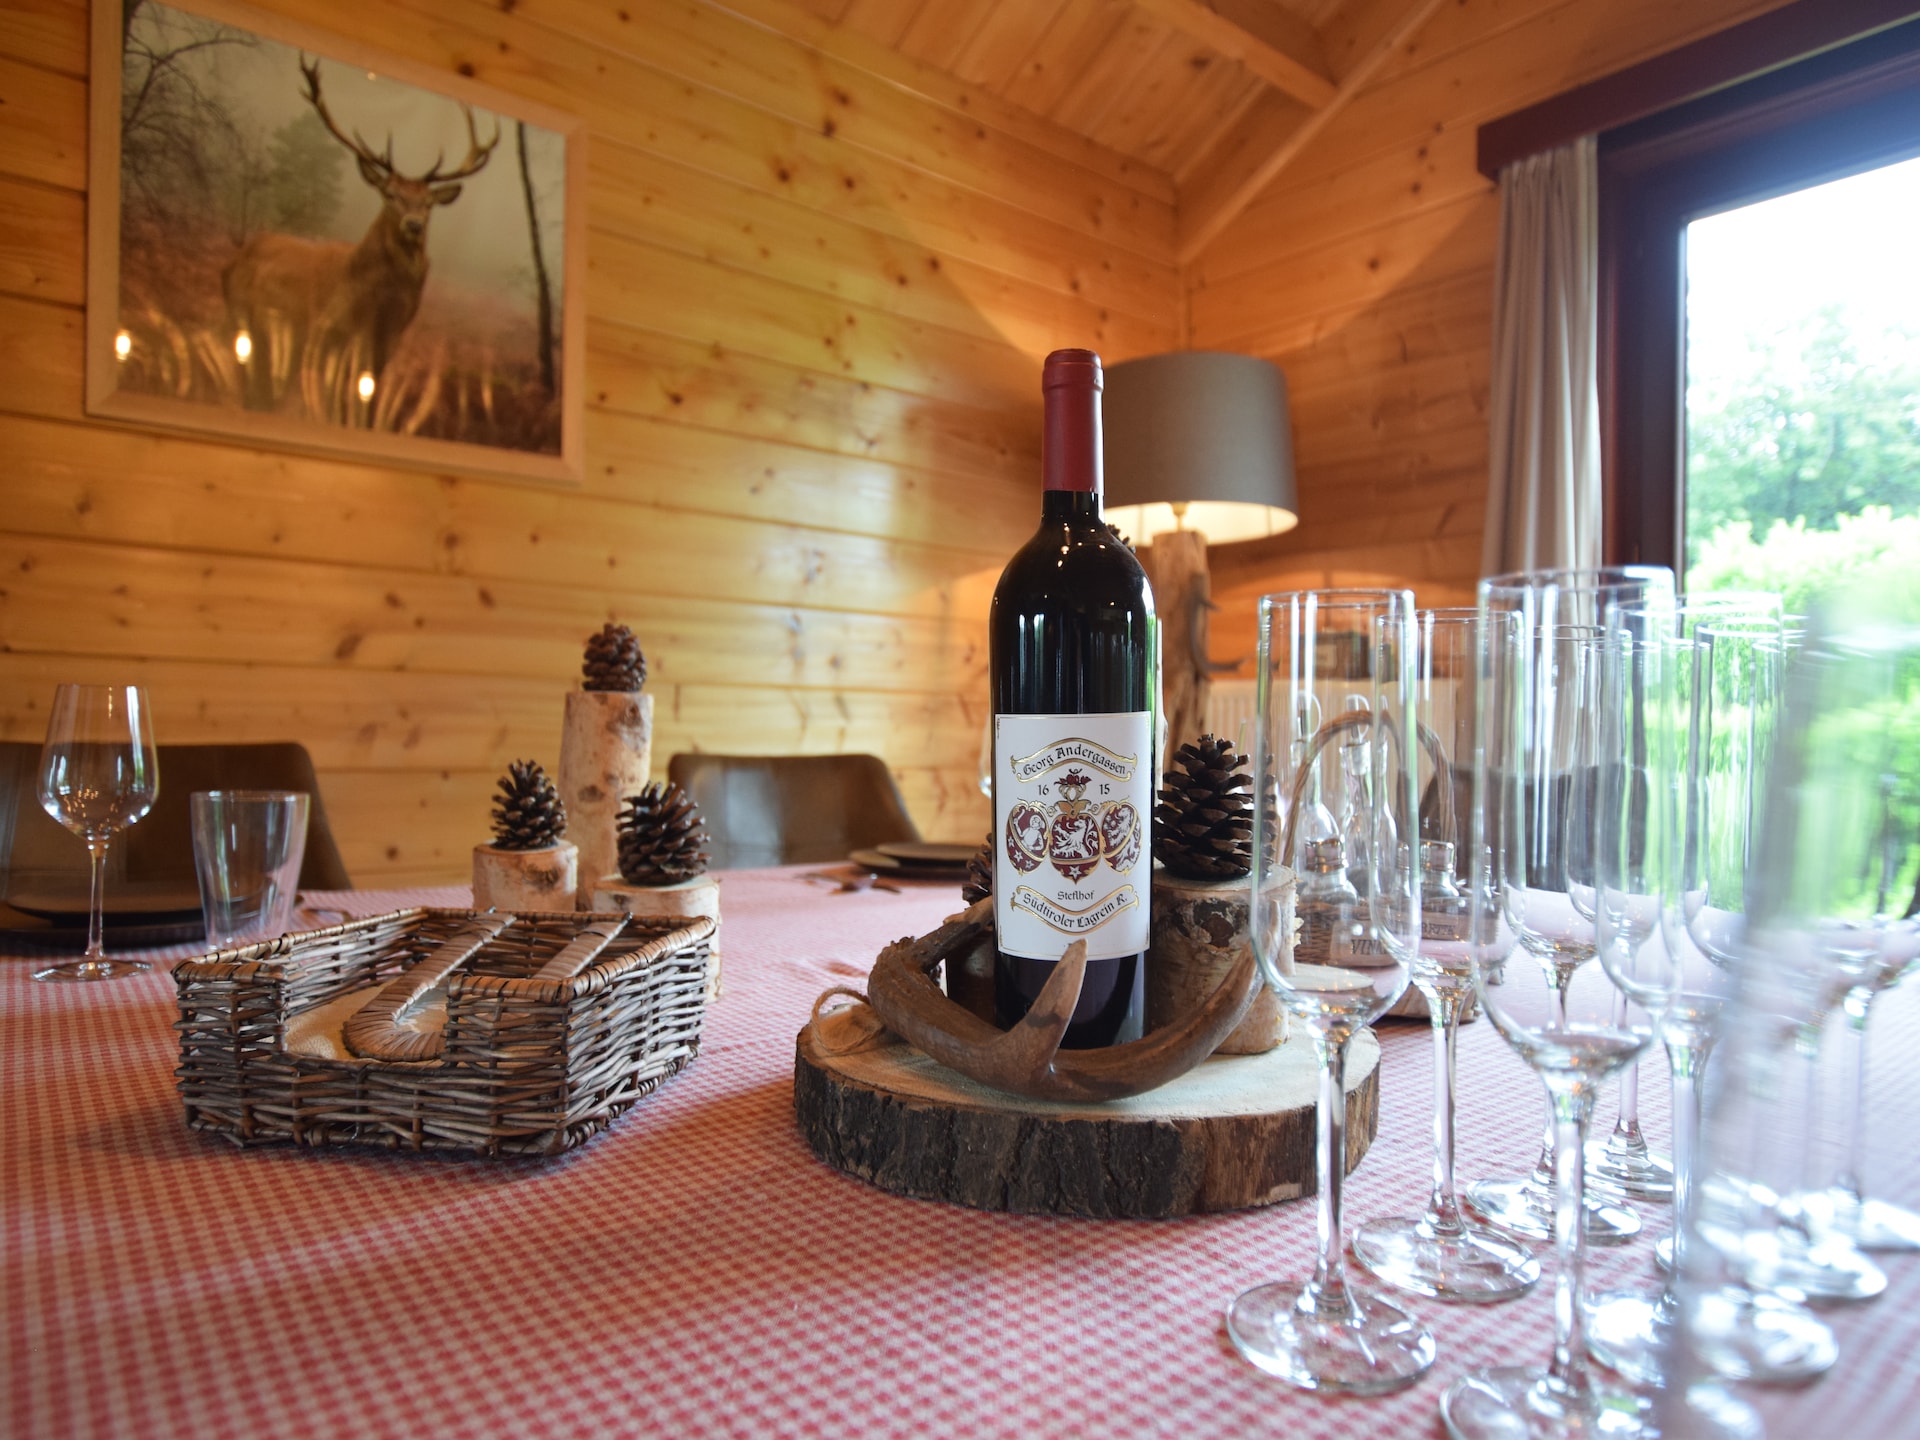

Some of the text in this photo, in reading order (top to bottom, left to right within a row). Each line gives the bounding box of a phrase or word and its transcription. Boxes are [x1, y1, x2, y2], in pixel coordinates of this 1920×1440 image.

[1023, 743, 1126, 776] Georg Andergassen
[1038, 783, 1111, 796] 16 15
[1057, 890, 1096, 901] Steflhof
[1022, 893, 1075, 928] Südtiroler
[1076, 902, 1115, 928] Lagrein
